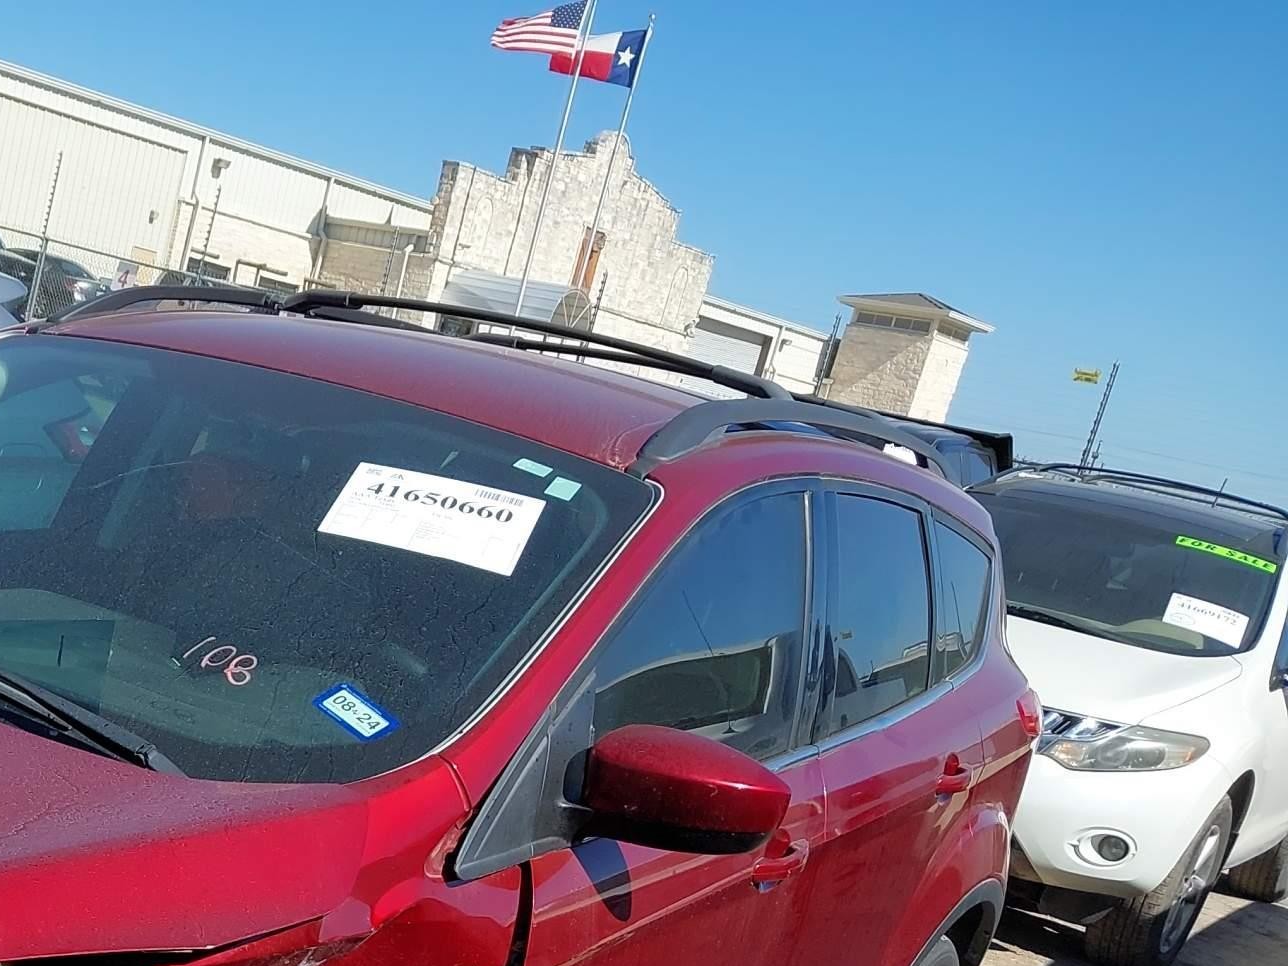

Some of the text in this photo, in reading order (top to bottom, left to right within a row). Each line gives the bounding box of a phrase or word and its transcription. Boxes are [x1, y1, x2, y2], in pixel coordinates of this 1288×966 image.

[117, 269, 129, 288] 4
[367, 482, 514, 523] 41650660
[1178, 537, 1274, 570] FOR SALE
